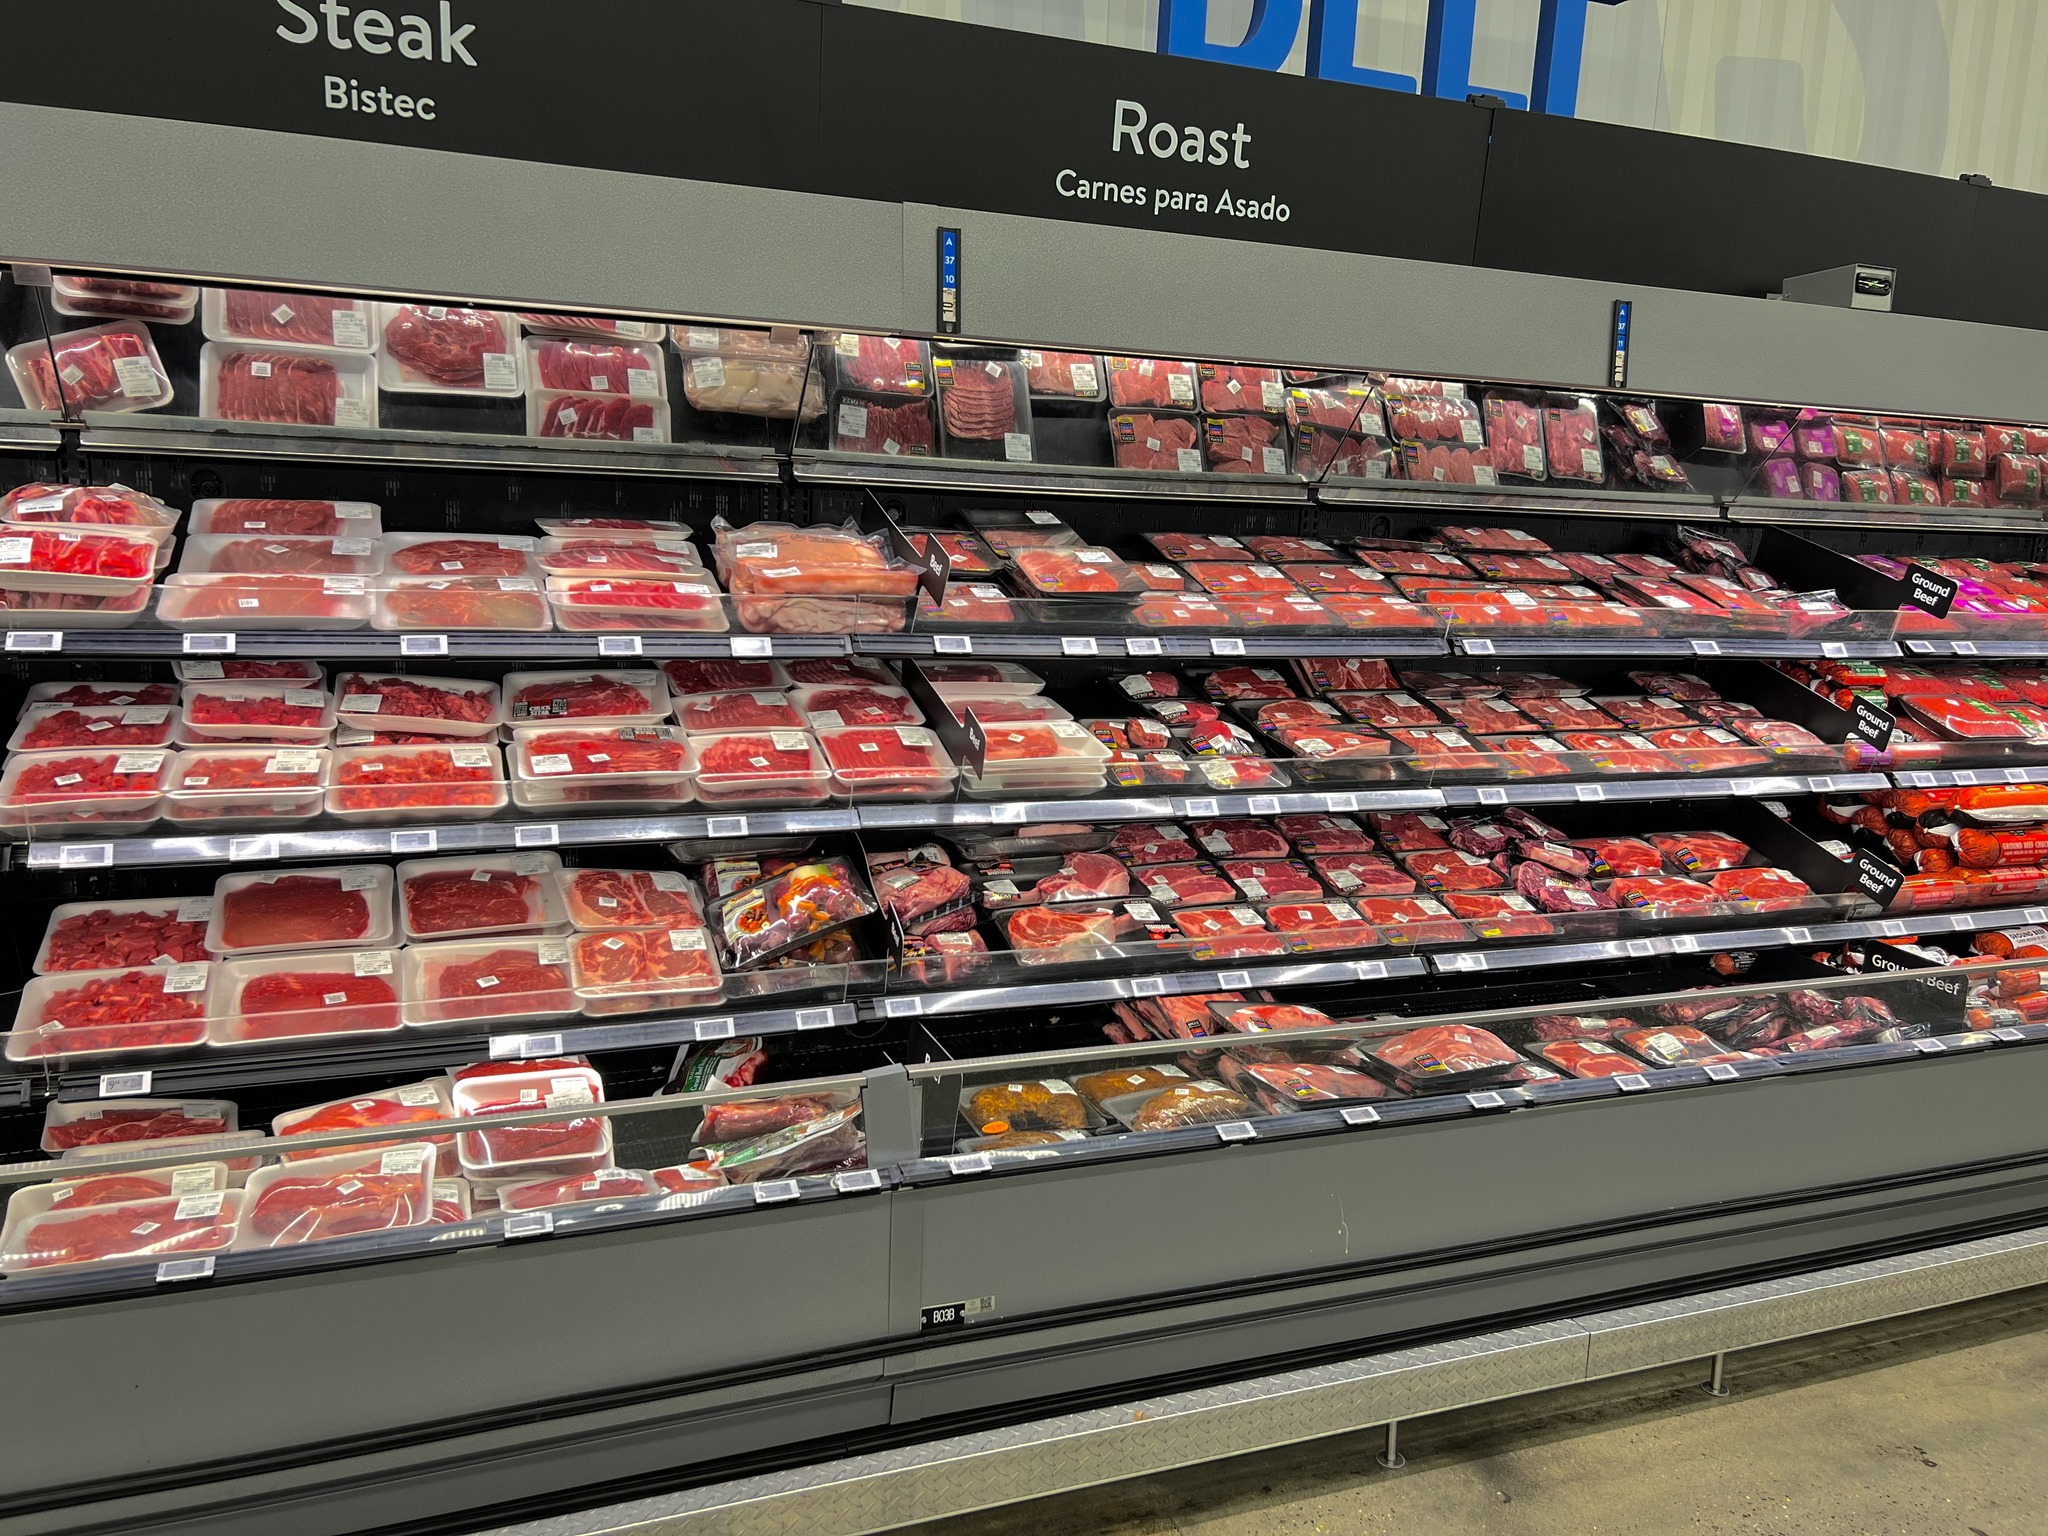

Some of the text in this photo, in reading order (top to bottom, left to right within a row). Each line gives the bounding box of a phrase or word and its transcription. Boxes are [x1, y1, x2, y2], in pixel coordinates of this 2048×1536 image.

[276, 0, 478, 67] Steak
[324, 75, 436, 121] Bistec
[1112, 99, 1252, 169] Roast
[1055, 168, 1291, 222] Carnes para Asado
[945, 237, 953, 246] A
[944, 256, 955, 265] 37
[945, 274, 955, 284] 10
[1911, 572, 1951, 598] Ground
[1913, 588, 1939, 607] Beef
[1856, 704, 1890, 732] Ground
[1857, 718, 1880, 740] Beef
[1859, 858, 1897, 888] Ground
[1859, 872, 1884, 895] Beef
[1926, 976, 1960, 996] Beef
